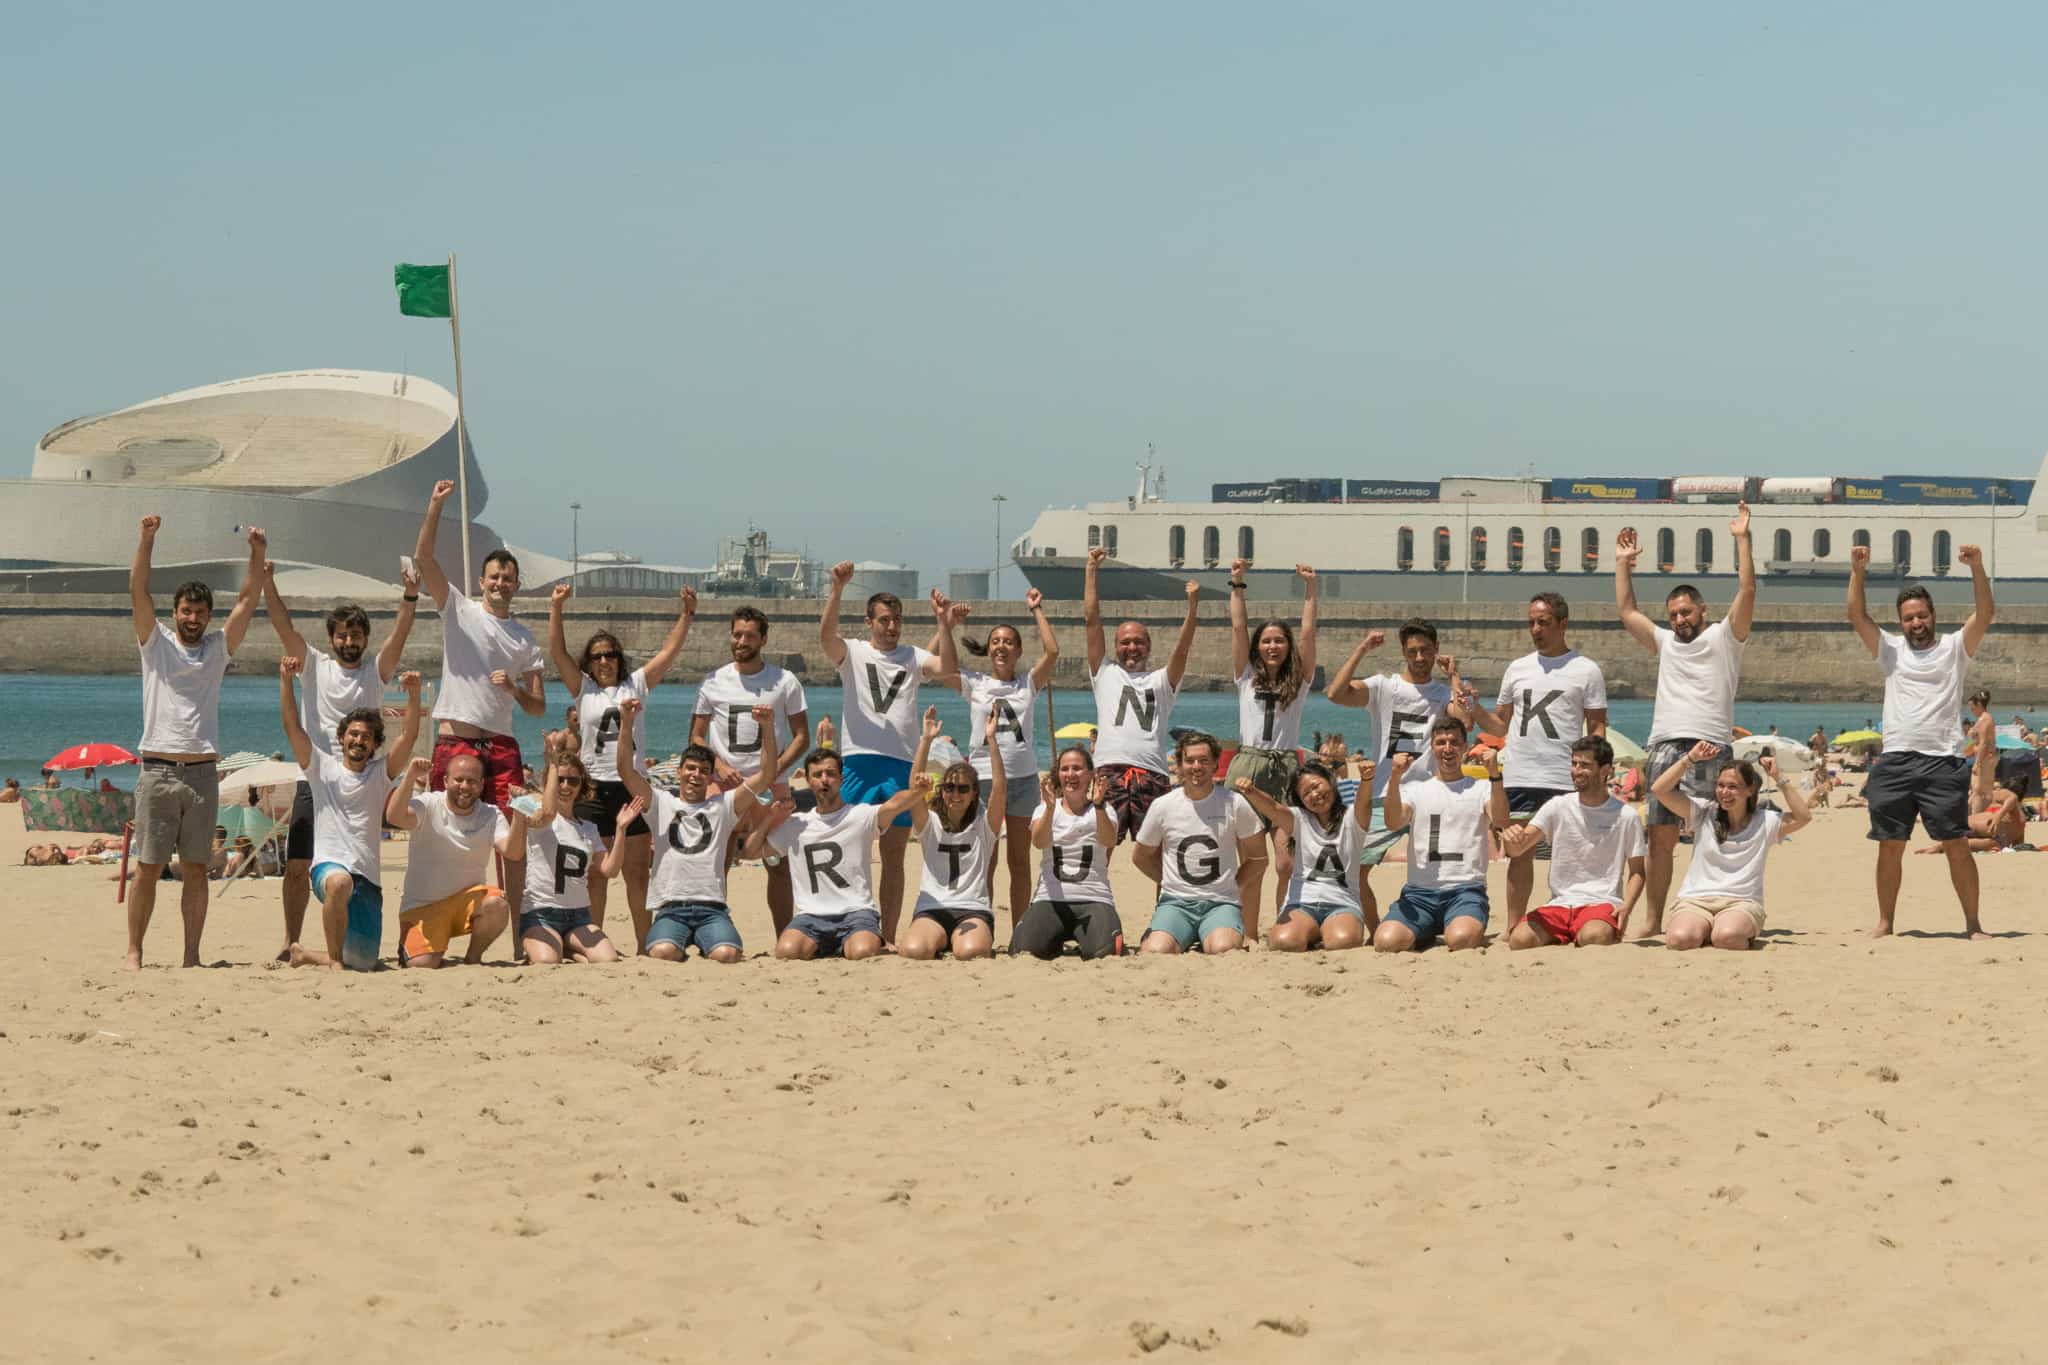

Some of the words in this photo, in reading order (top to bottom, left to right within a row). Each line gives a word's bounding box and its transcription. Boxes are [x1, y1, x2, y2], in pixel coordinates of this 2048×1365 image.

[867, 664, 907, 713] V
[1115, 685, 1155, 732] N
[595, 706, 637, 754] A
[728, 704, 765, 753] D
[983, 699, 1025, 746] A
[1254, 690, 1283, 741] T
[1386, 711, 1429, 760] E
[1520, 689, 1564, 739] K
[668, 811, 713, 855] O
[1428, 813, 1464, 862] L
[555, 843, 588, 895] P
[804, 841, 850, 893] R
[937, 843, 971, 889] T
[1052, 845, 1093, 883] U
[1177, 834, 1220, 885] G
[1306, 844, 1349, 889] A
